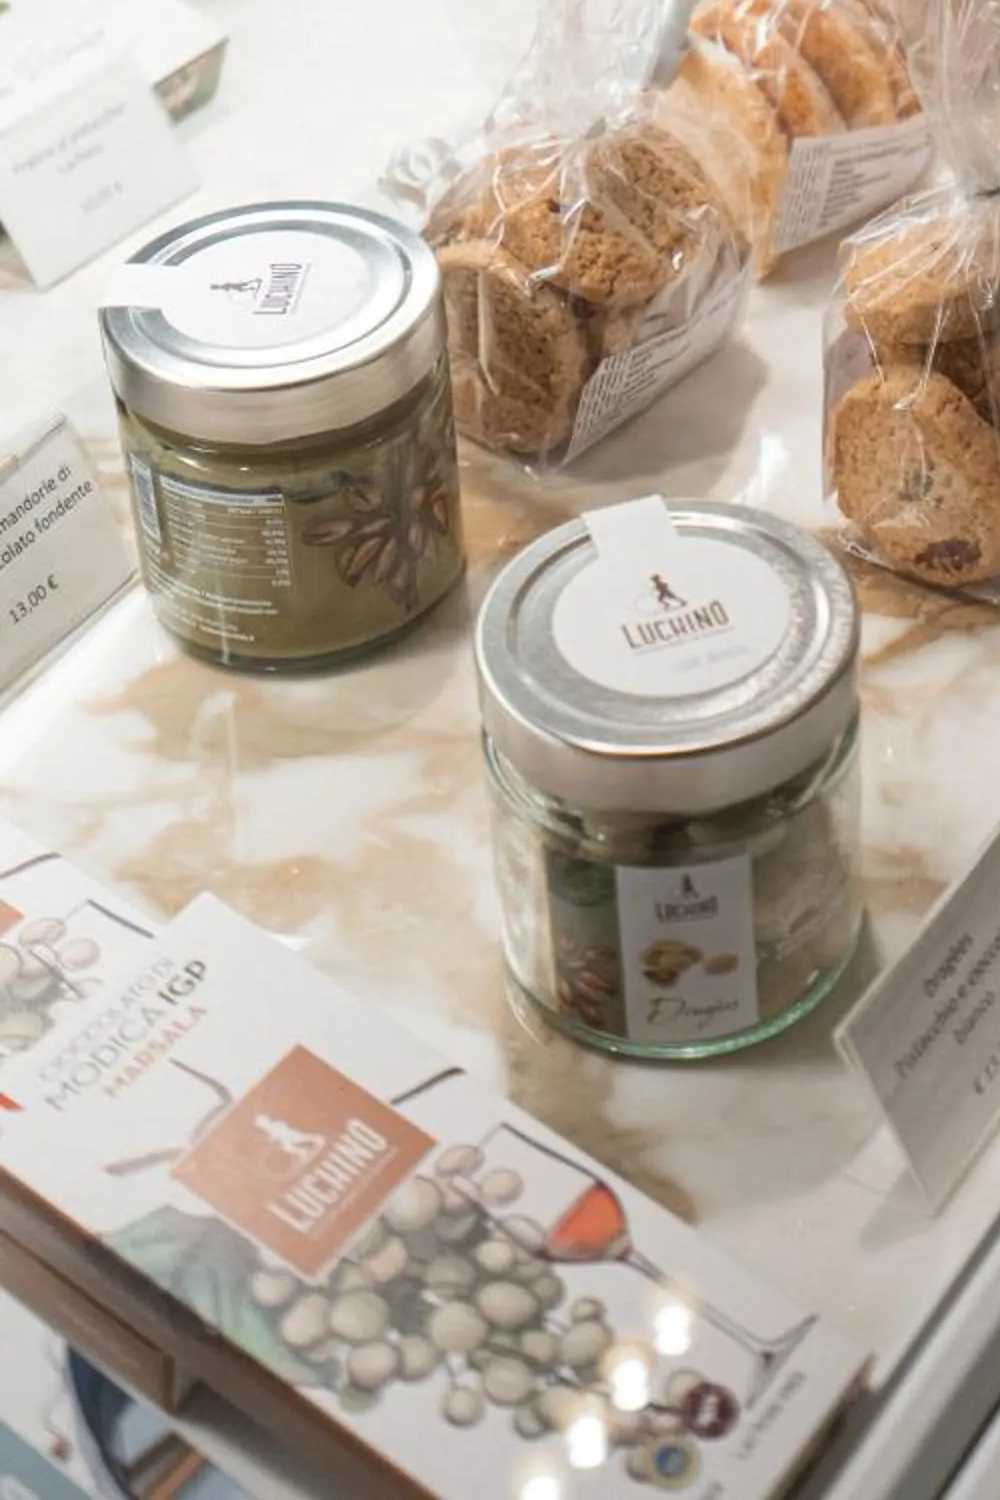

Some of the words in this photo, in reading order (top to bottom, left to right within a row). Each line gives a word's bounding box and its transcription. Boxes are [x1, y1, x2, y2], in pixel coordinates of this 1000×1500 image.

[34, 480, 93, 533] fondente
[9, 584, 47, 625] 13,00
[47, 573, 60, 591] €
[620, 600, 730, 649] LUCHINO
[655, 895, 719, 923] LUCHINO
[44, 1006, 167, 1112] MODICA
[157, 960, 207, 1006] IGP
[104, 1004, 208, 1098] MARSALA
[266, 1118, 387, 1234] LUCHINO
